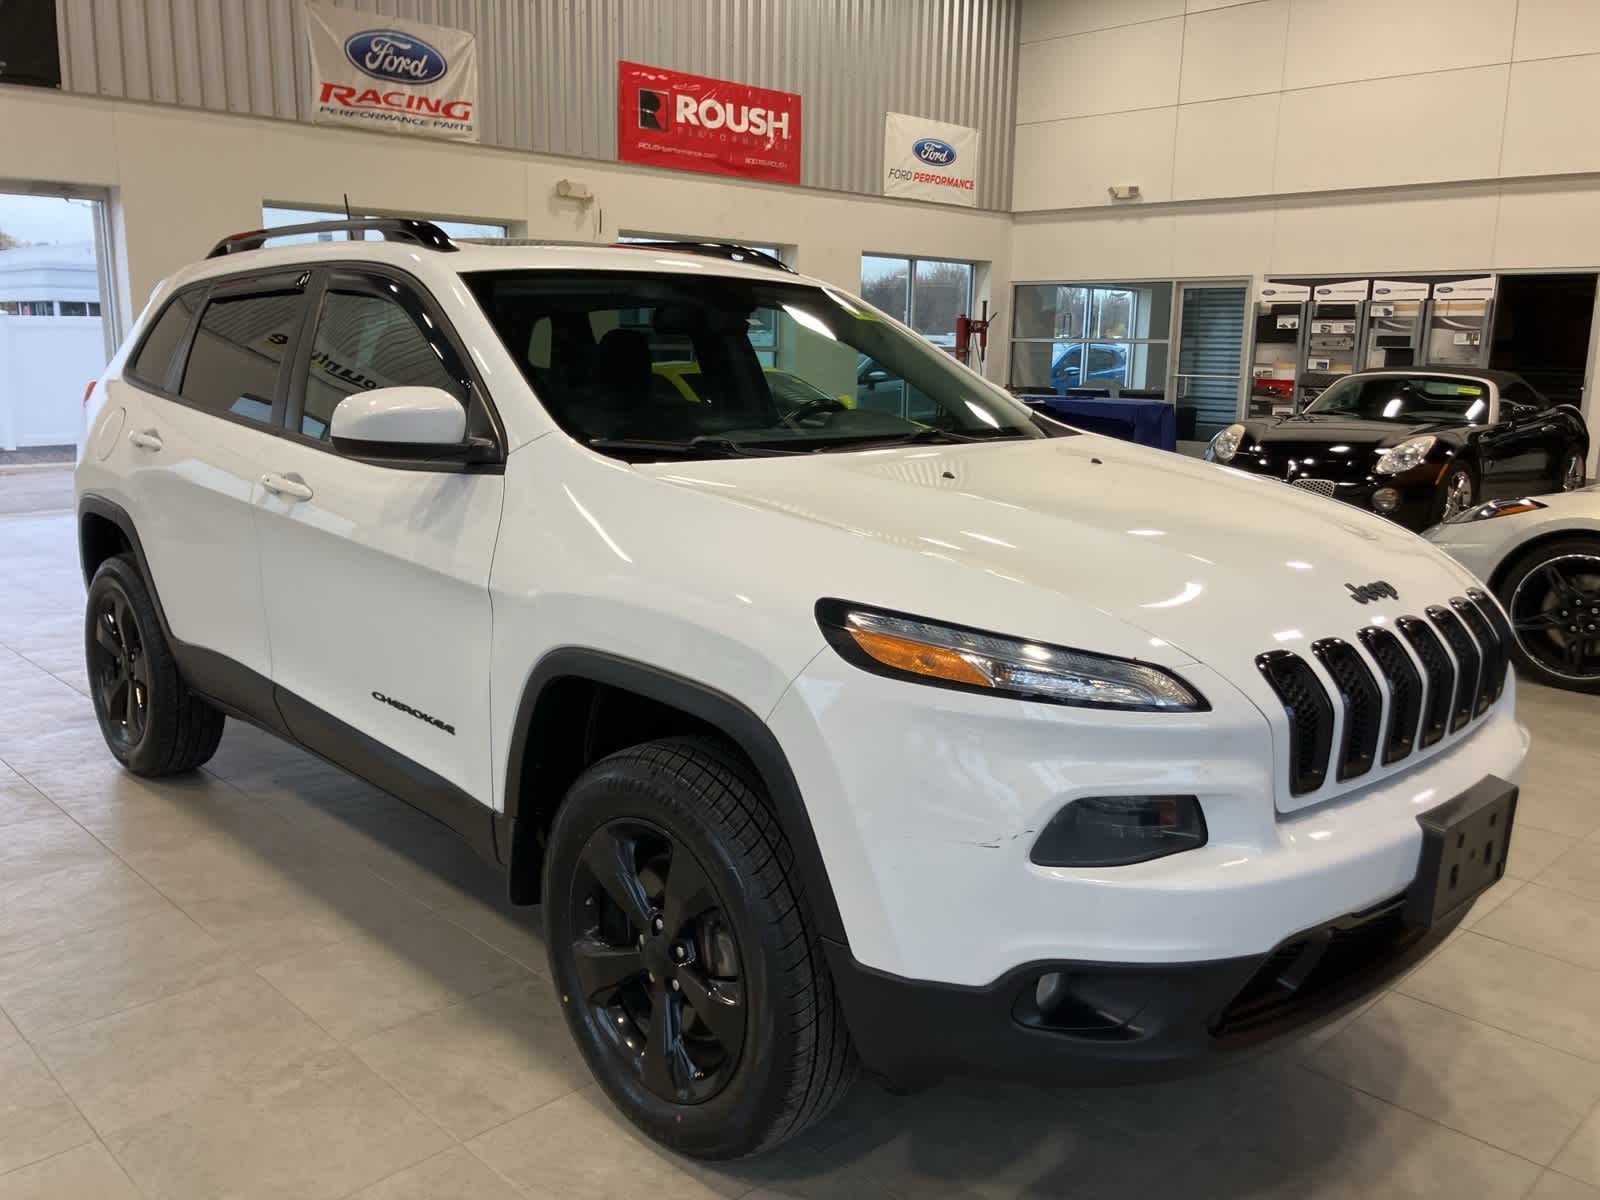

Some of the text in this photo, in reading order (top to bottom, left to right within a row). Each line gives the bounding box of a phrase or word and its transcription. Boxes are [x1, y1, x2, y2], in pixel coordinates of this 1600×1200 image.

[365, 36, 428, 78] Ford
[320, 82, 473, 121] RACING
[676, 94, 789, 140] ROUSH
[320, 105, 473, 132] PERFORMANCE PARTS
[920, 142, 949, 162] Ford
[888, 168, 975, 190] FORD PERFORMANCE
[1344, 580, 1399, 605] Jeep
[371, 691, 456, 736] CHEROKEE
